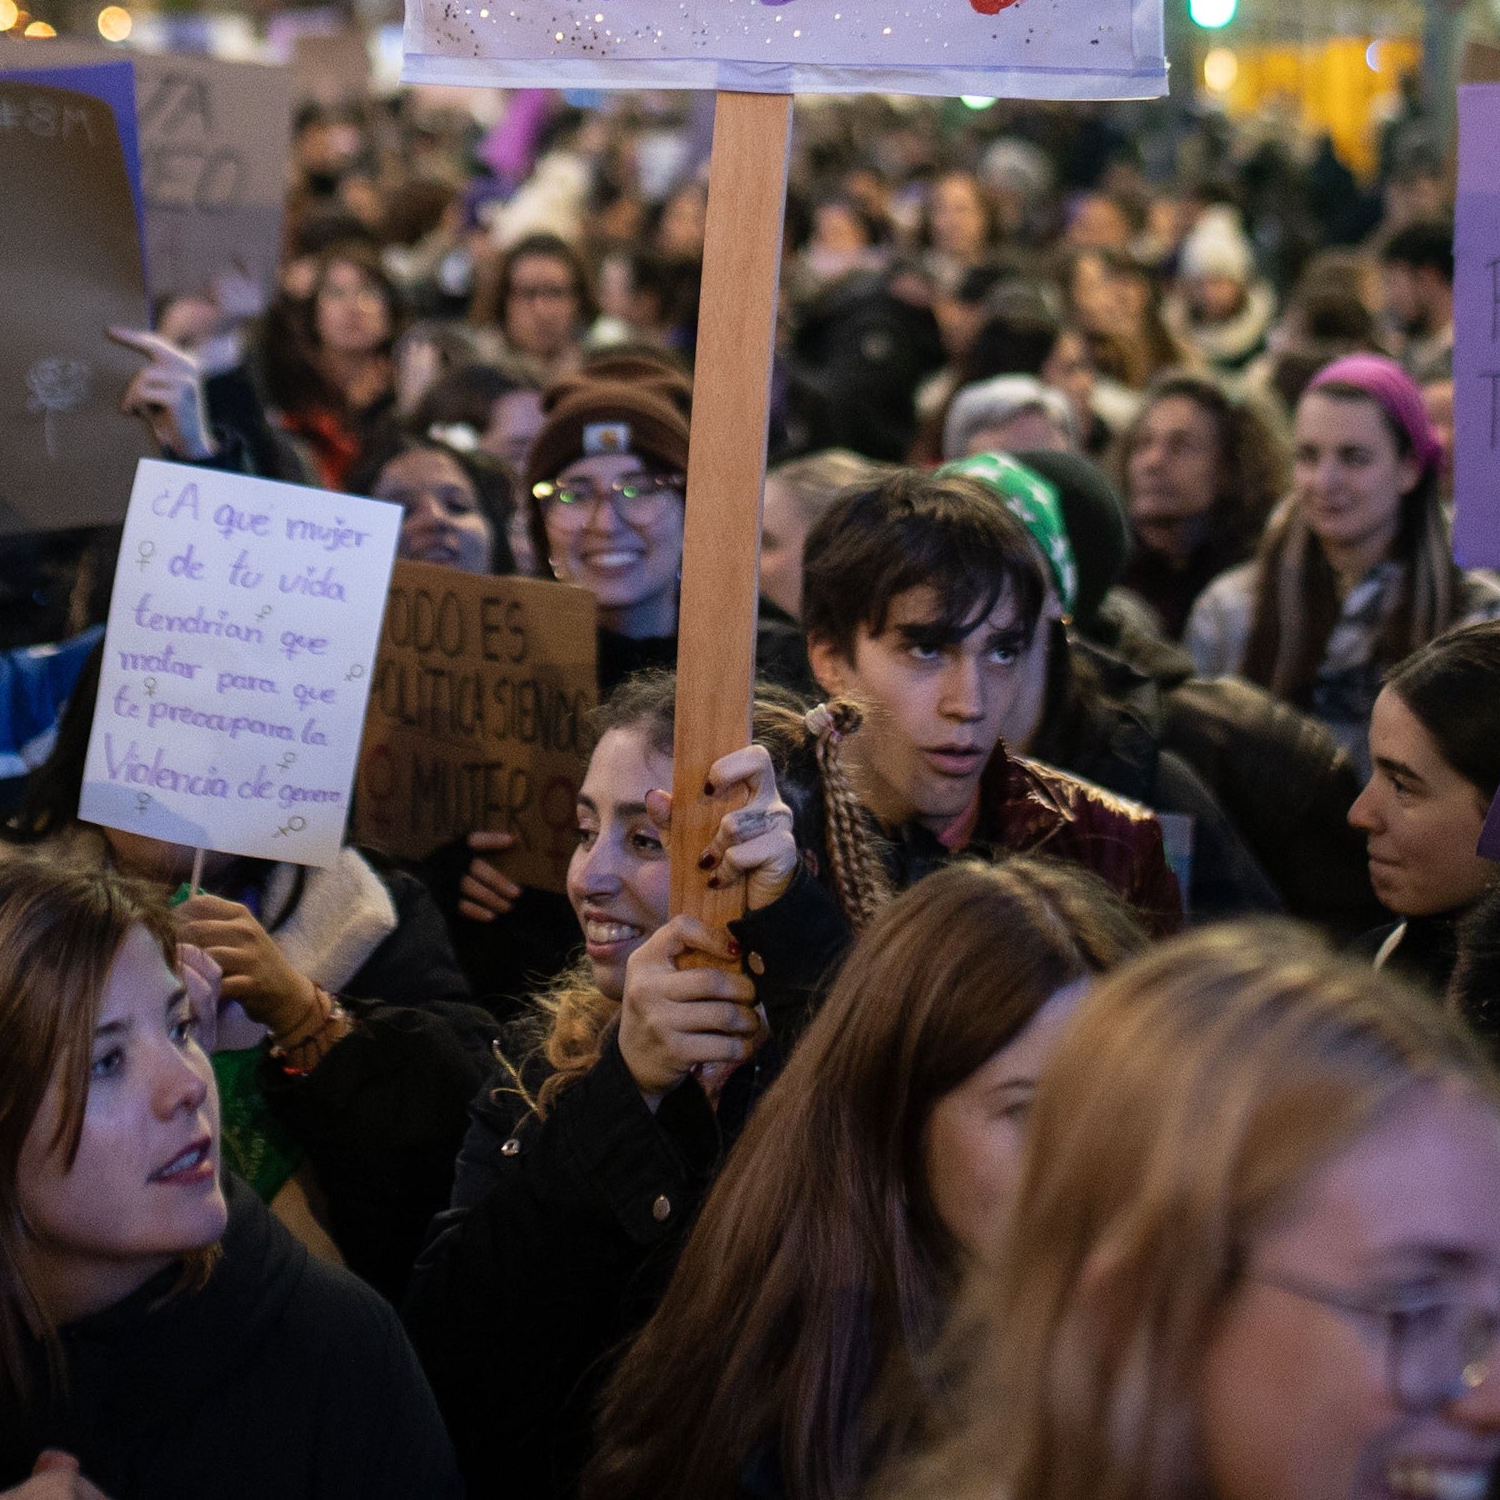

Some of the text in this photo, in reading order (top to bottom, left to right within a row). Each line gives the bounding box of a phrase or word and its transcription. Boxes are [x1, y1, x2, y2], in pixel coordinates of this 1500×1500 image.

[286, 516, 371, 551] mujer
[167, 543, 346, 602] de tu vida
[280, 630, 329, 661] que
[480, 595, 529, 665] ES
[118, 643, 338, 712] matar para que
[112, 684, 141, 719] te
[301, 717, 328, 747] la
[104, 732, 230, 799] Violencia
[237, 764, 274, 800] de
